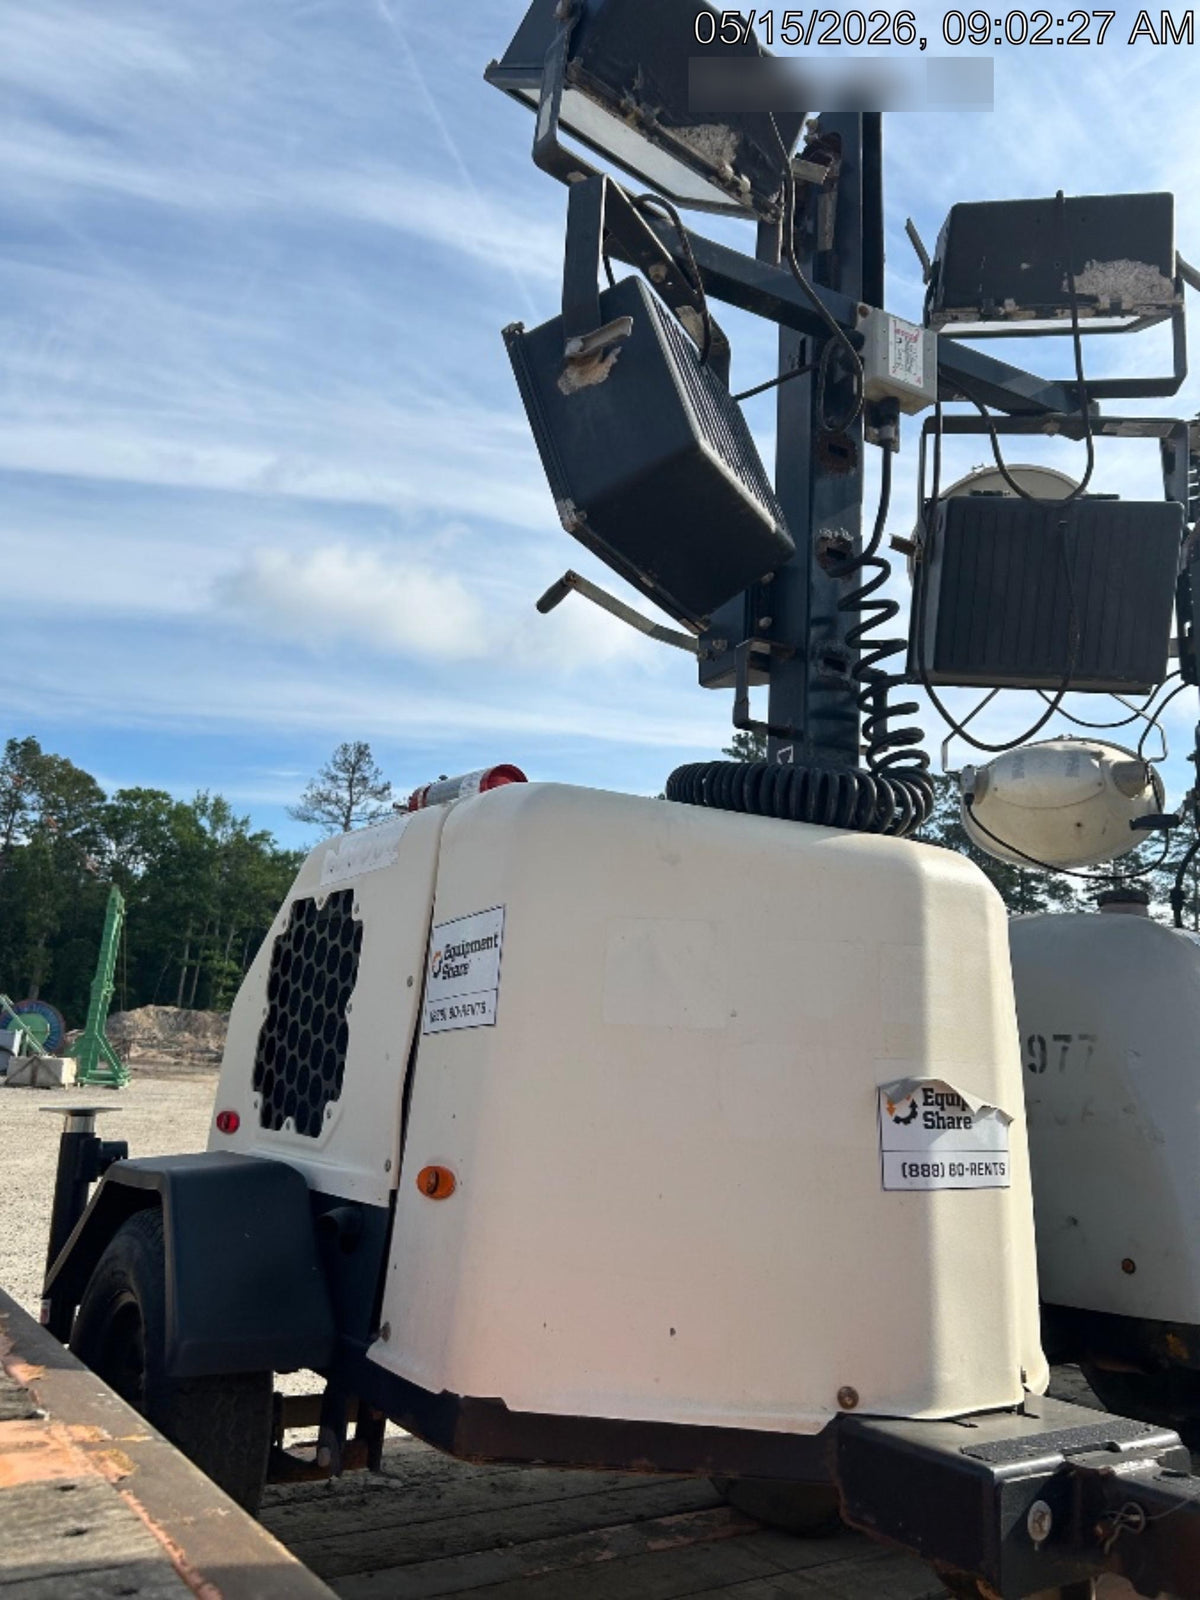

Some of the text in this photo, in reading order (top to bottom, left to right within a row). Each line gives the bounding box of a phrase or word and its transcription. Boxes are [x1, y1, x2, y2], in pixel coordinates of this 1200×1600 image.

[923, 1111, 973, 1130] Share
[902, 1162, 1006, 1178] (888) 80-RENTS
